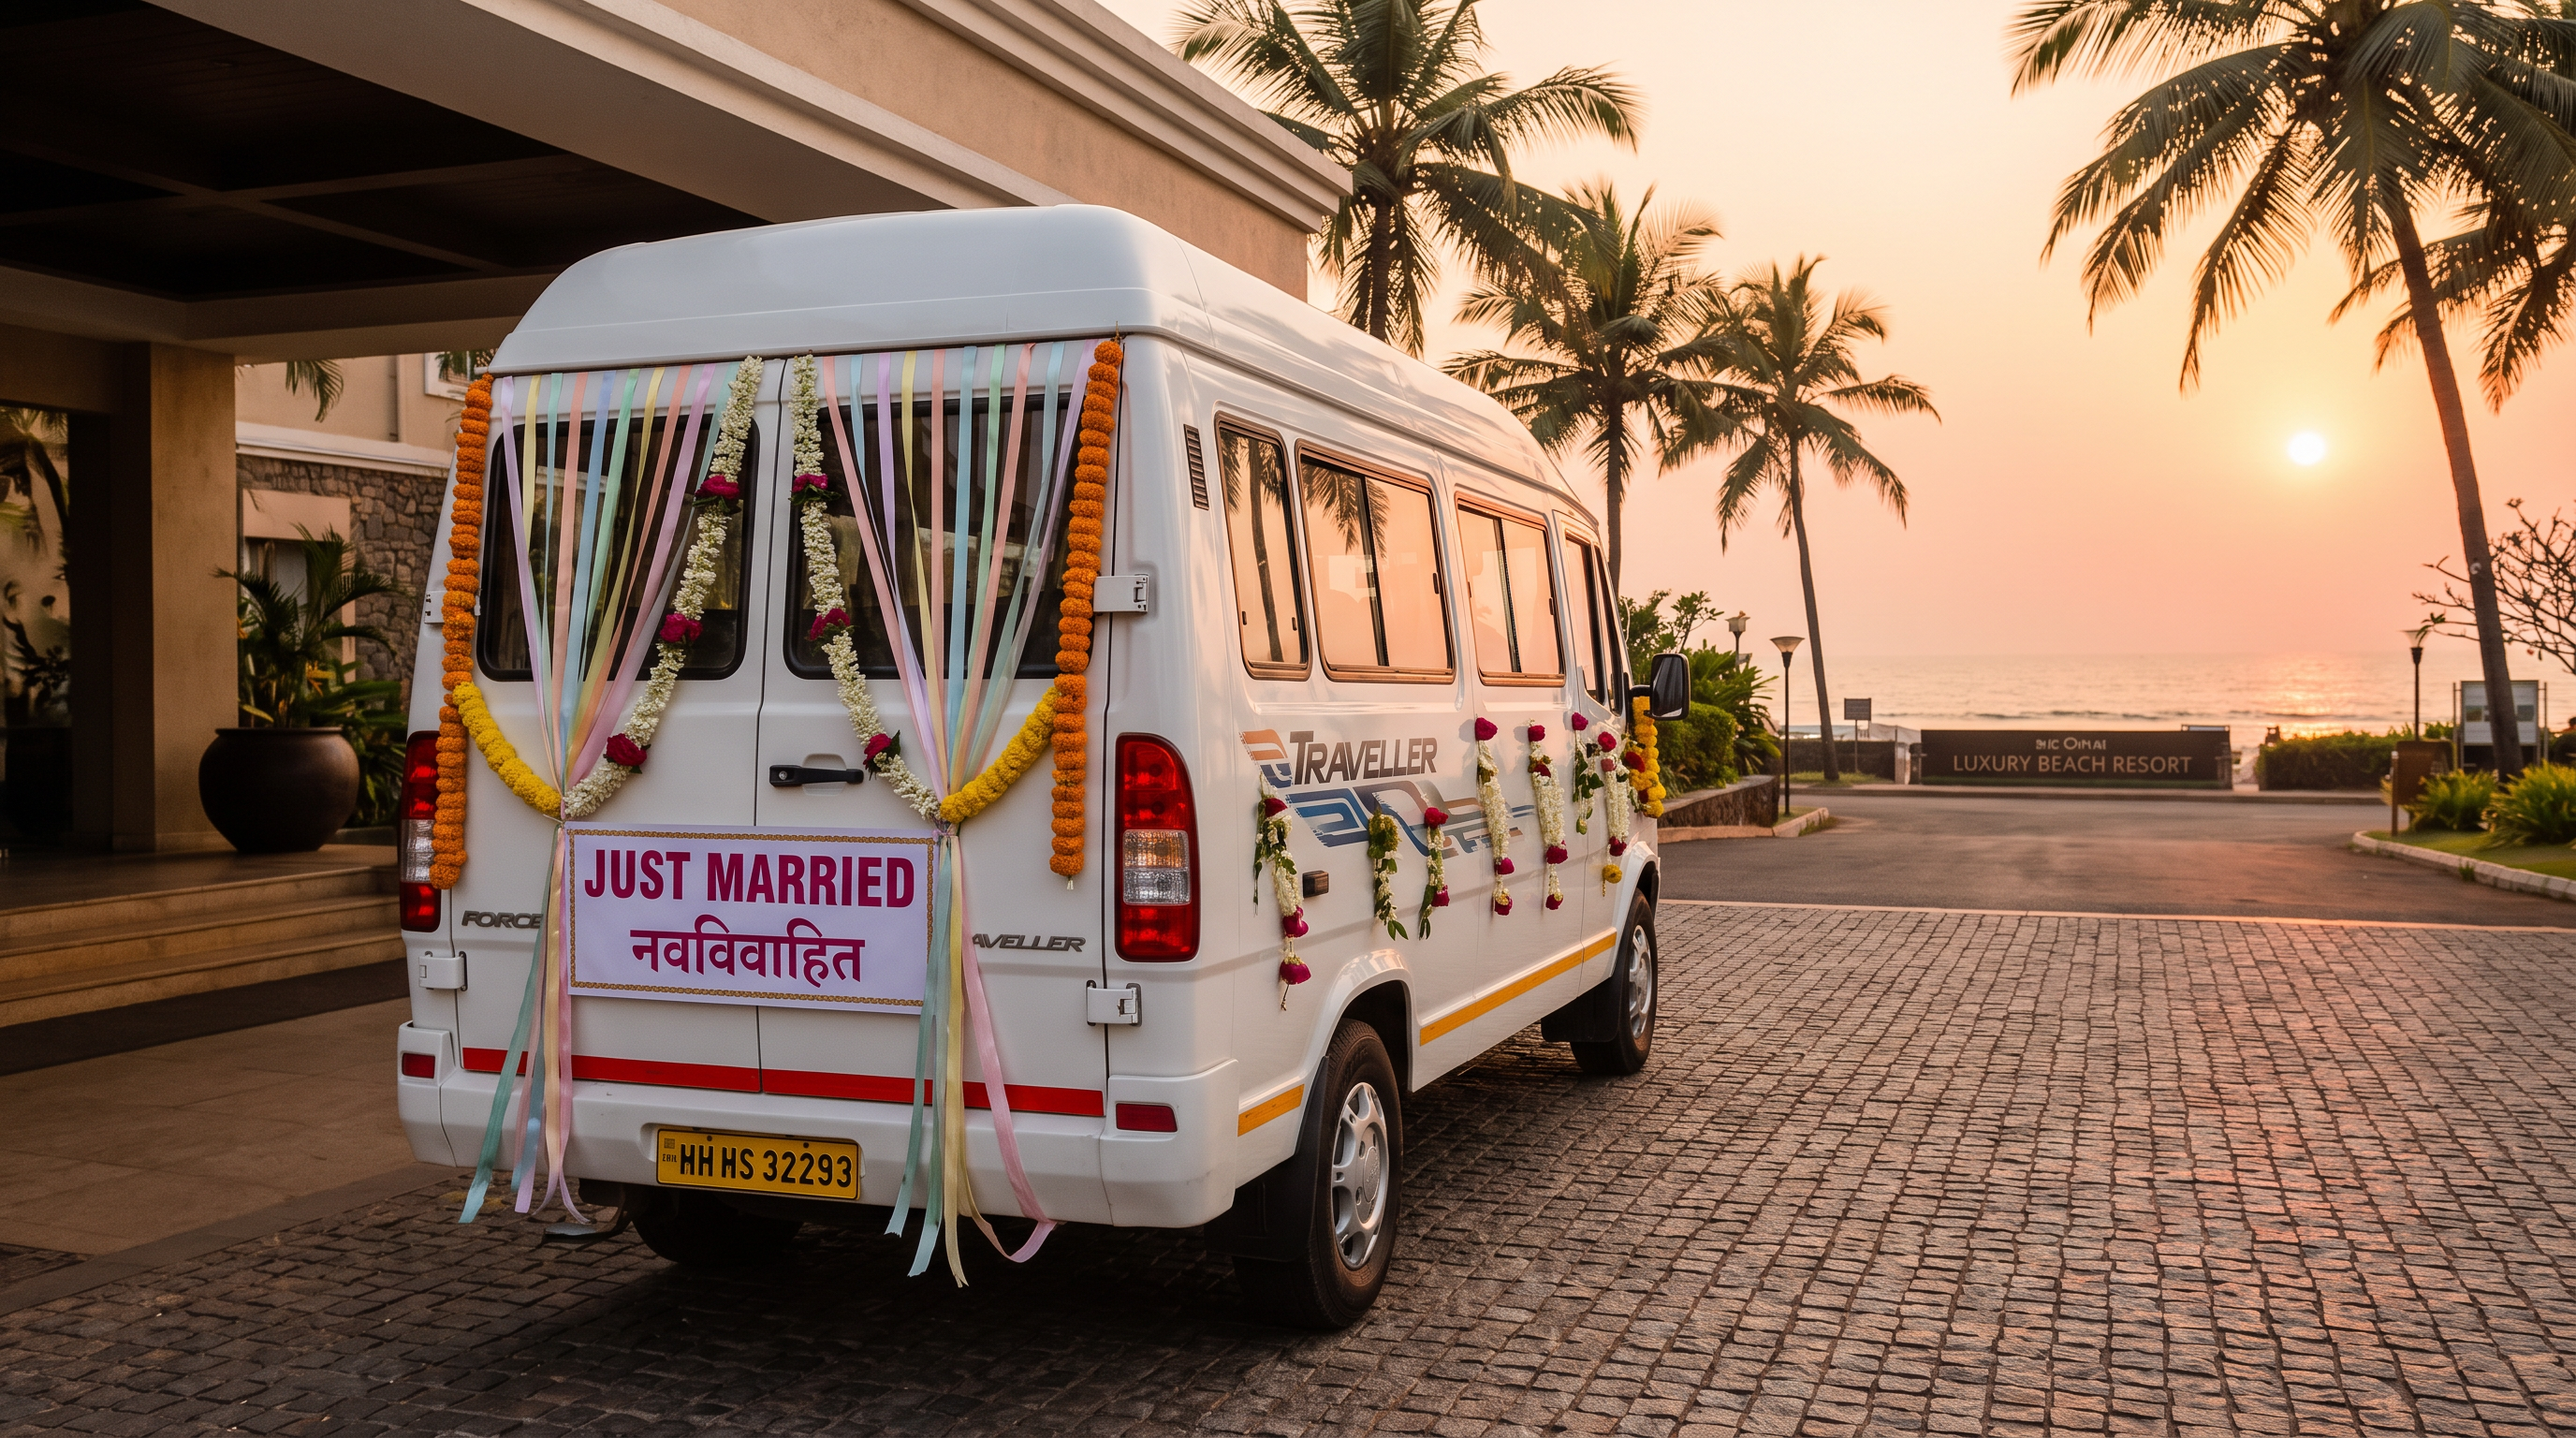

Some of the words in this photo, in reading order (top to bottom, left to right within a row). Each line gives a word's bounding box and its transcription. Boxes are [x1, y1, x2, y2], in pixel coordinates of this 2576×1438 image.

[1290, 730, 1438, 785] TRAVELLER
[1954, 755, 2031, 772] LUXURY
[2038, 755, 2106, 773] BEACH
[2113, 756, 2192, 774] RESORT
[584, 849, 691, 901] JUST
[707, 852, 915, 908] MARRIED
[461, 910, 543, 930] FORCE
[630, 914, 866, 988] नवविवाहित
[972, 933, 1086, 953] AVELLER
[722, 1146, 754, 1181] HS
[763, 1150, 852, 1188] 32293
